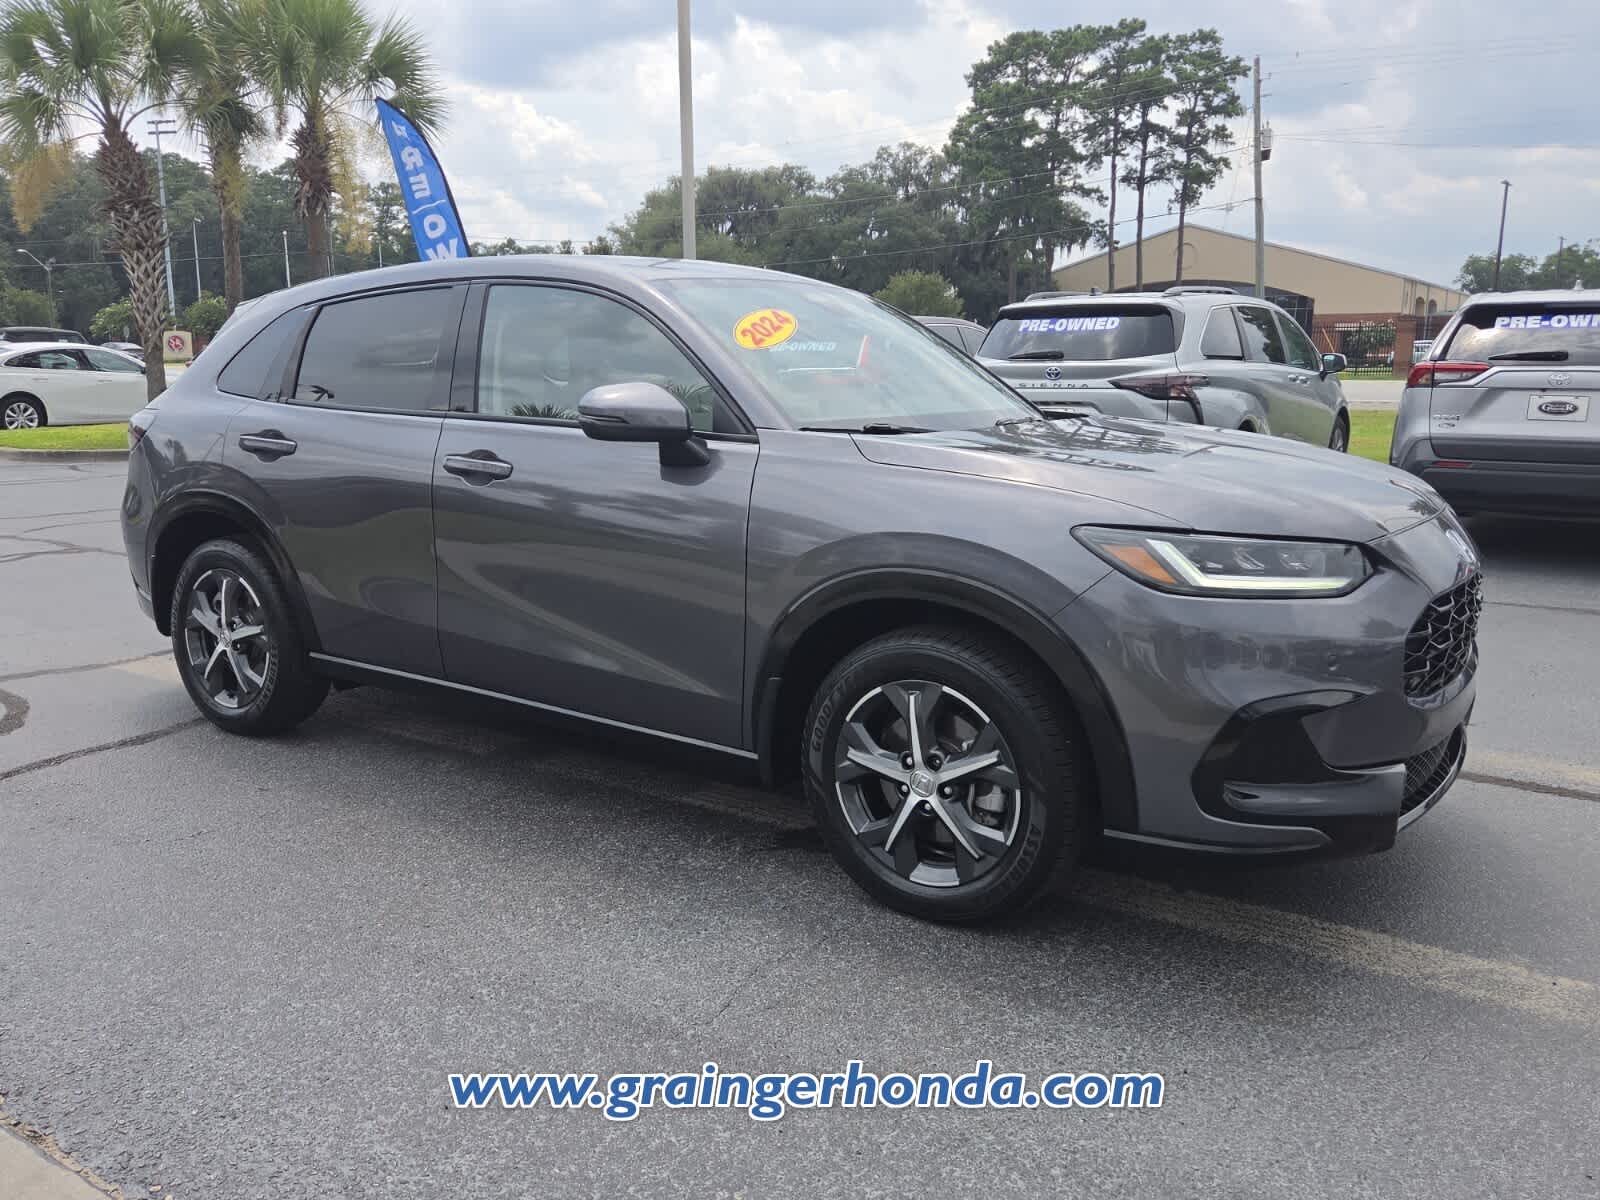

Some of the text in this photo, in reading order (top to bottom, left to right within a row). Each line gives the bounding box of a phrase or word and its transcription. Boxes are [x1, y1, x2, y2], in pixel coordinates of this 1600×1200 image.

[740, 309, 794, 346] 2024
[1019, 316, 1120, 332] PRE-OWNED
[769, 341, 838, 353] E-OWNED
